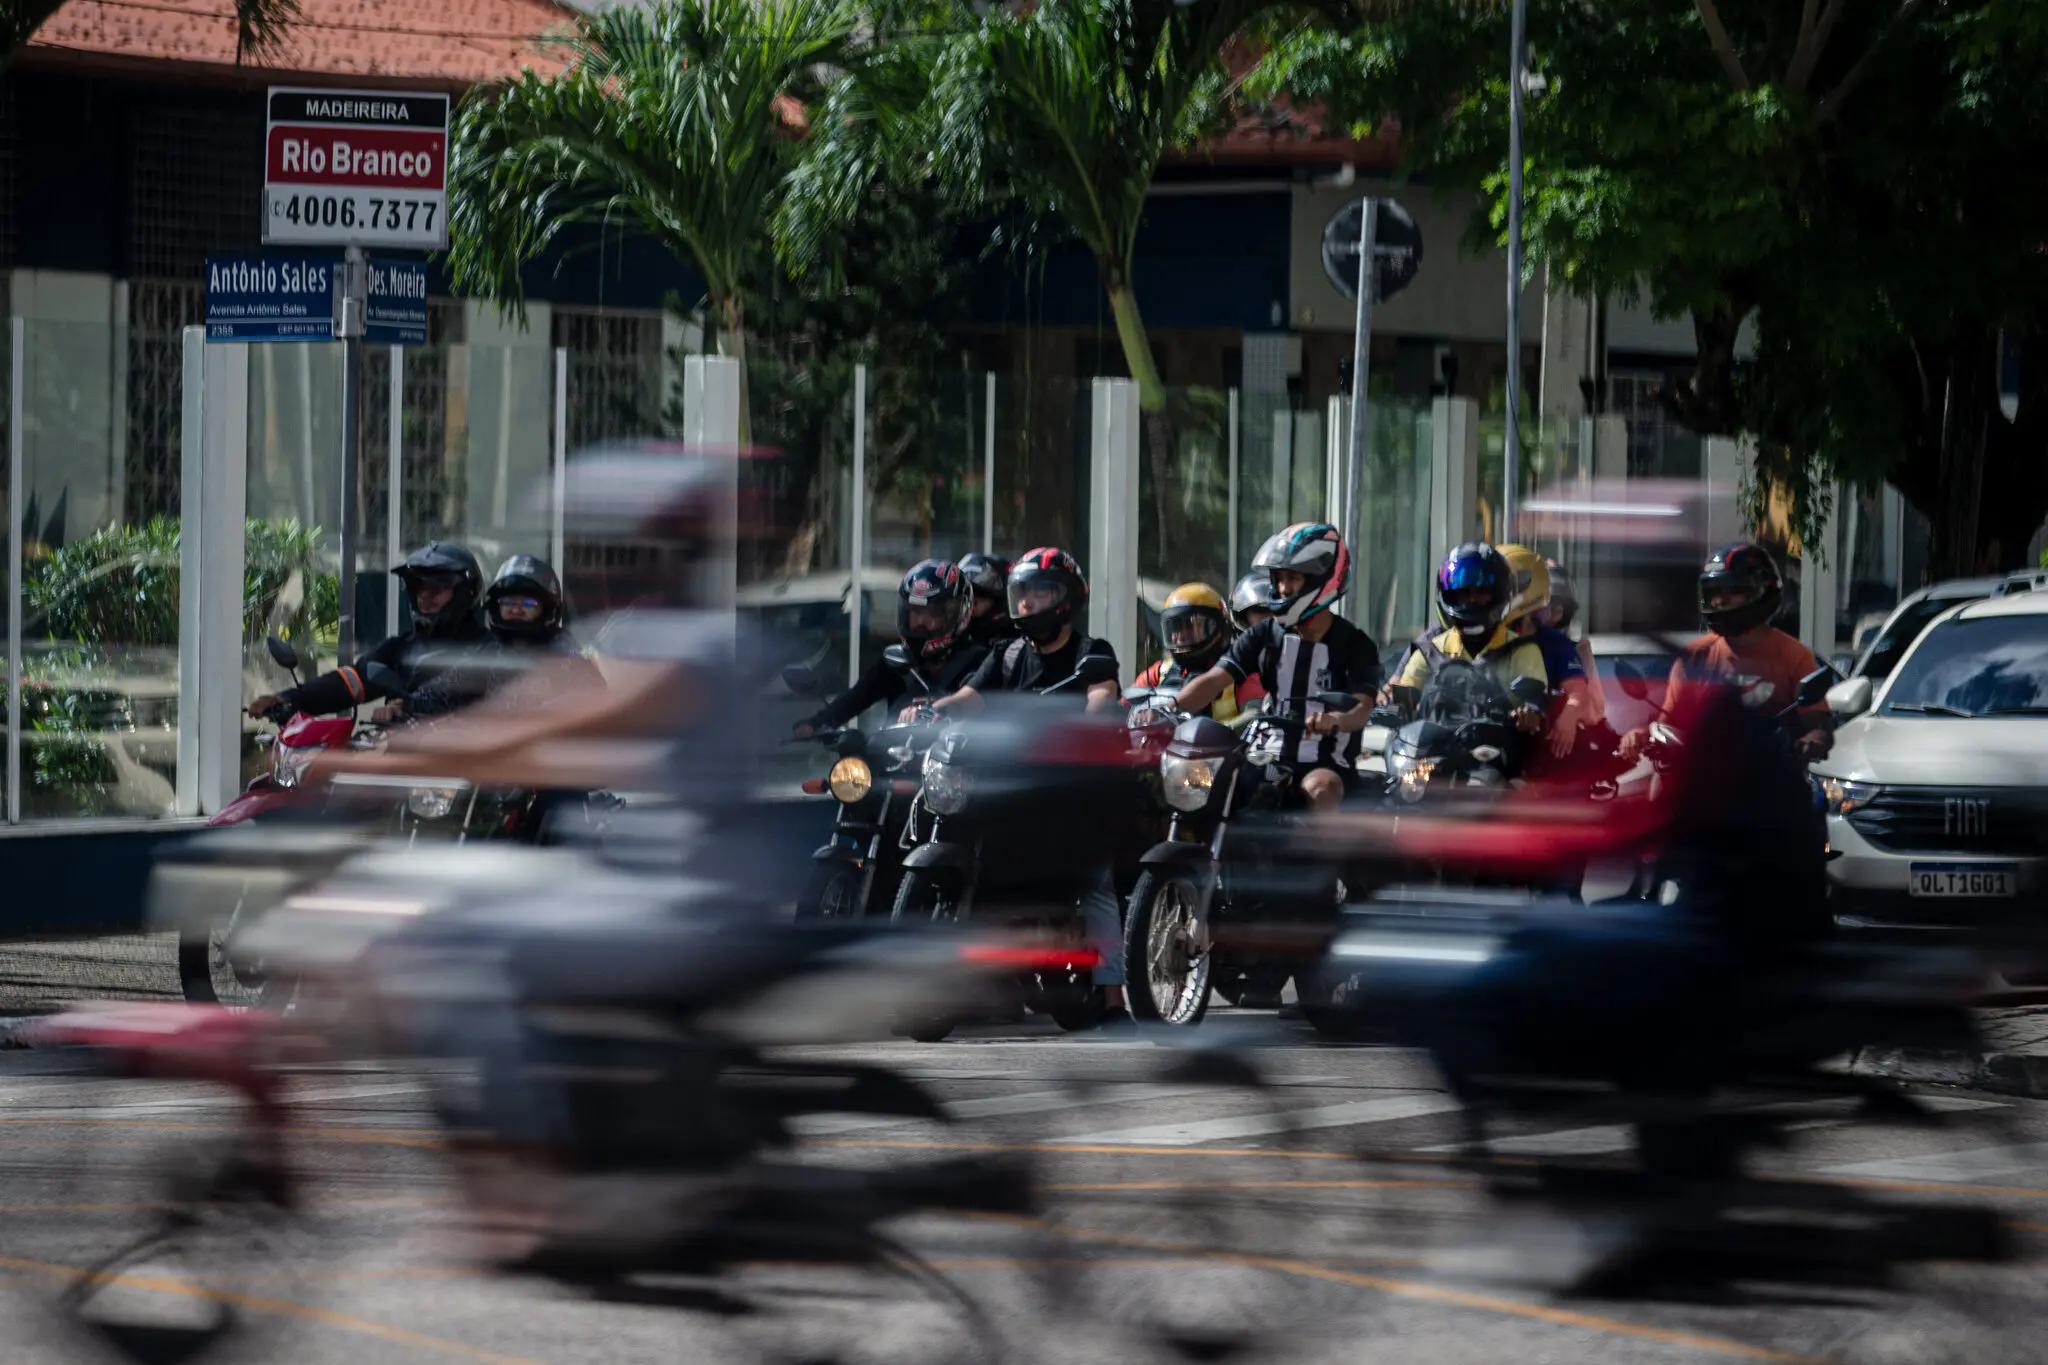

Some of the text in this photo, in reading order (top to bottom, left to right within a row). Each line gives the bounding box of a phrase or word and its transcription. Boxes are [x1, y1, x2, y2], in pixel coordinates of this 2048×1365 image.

[306, 99, 409, 120] MADEIREIRA
[282, 138, 432, 178] Rio Branco
[286, 194, 437, 232] 4006.7377
[210, 259, 326, 293] Antônio Sales
[368, 264, 425, 299] Des. Moreira
[210, 303, 307, 316] Avenida Antônio Sales
[1944, 797, 1990, 836] FIAT
[1920, 873, 2007, 893] QLT1G01
